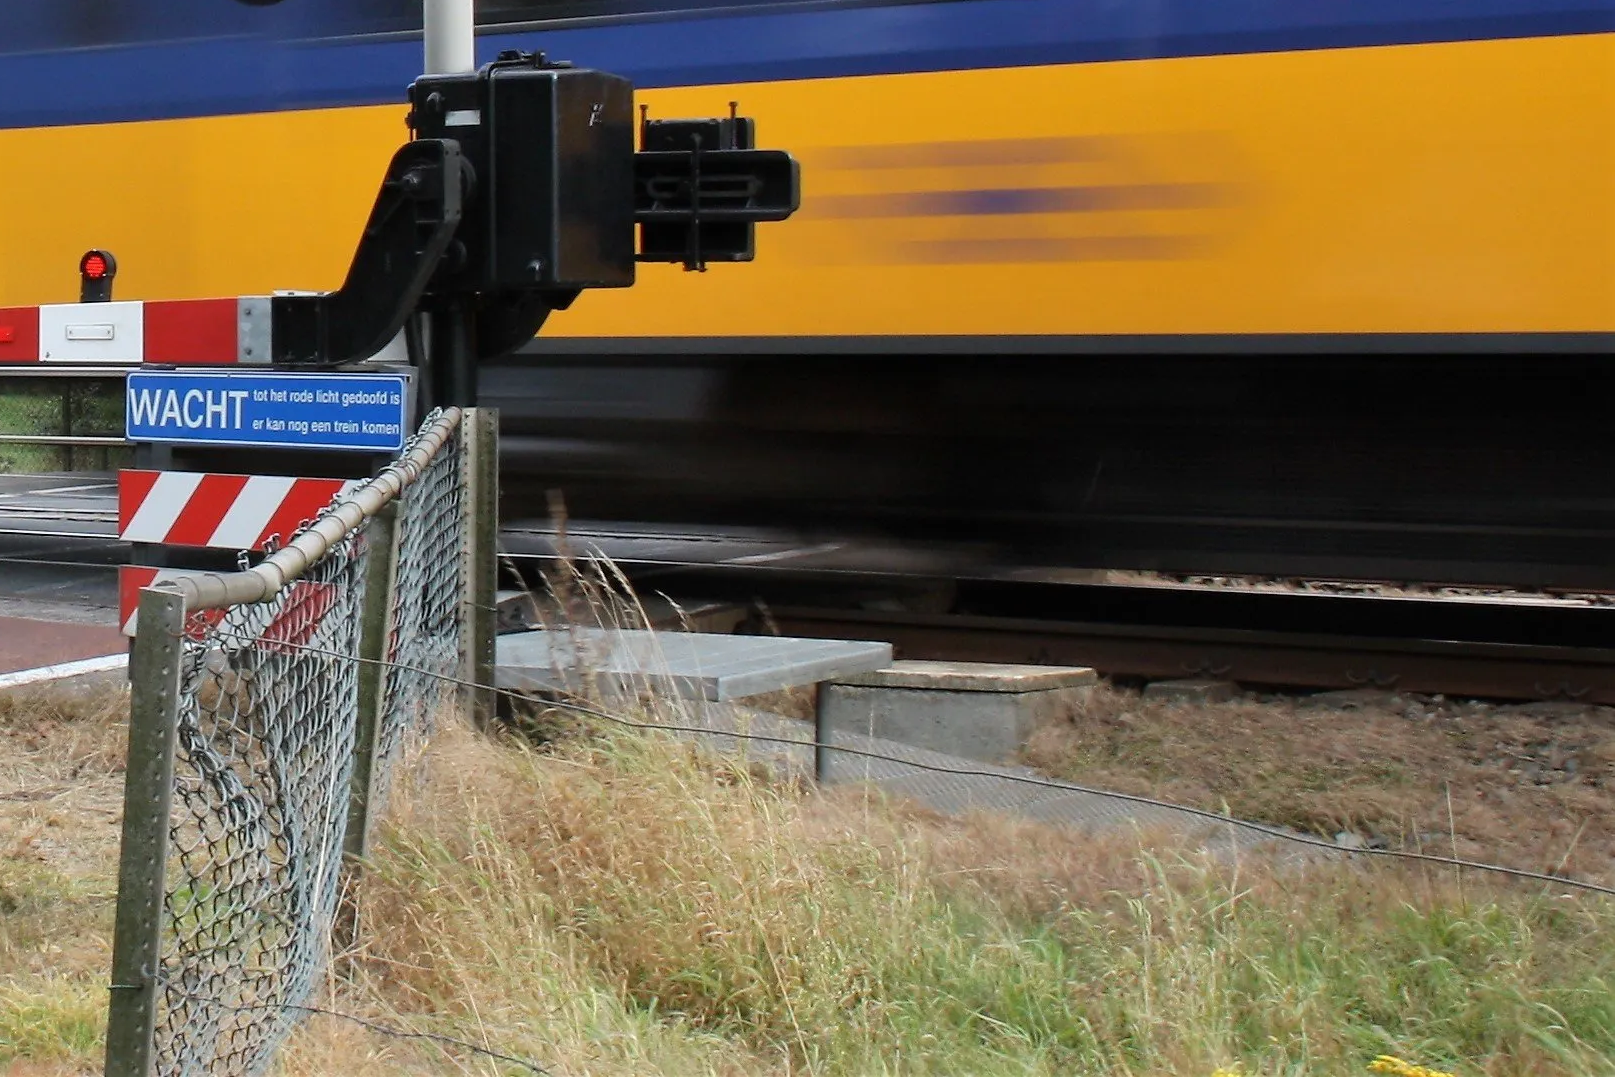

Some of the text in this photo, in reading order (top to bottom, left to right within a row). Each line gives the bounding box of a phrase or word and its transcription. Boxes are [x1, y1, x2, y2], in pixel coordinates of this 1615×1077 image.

[253, 389, 401, 407] tot het rode licht gedoofd is
[129, 388, 249, 429] WACHT
[252, 417, 399, 435] er kan nog een trein komen
